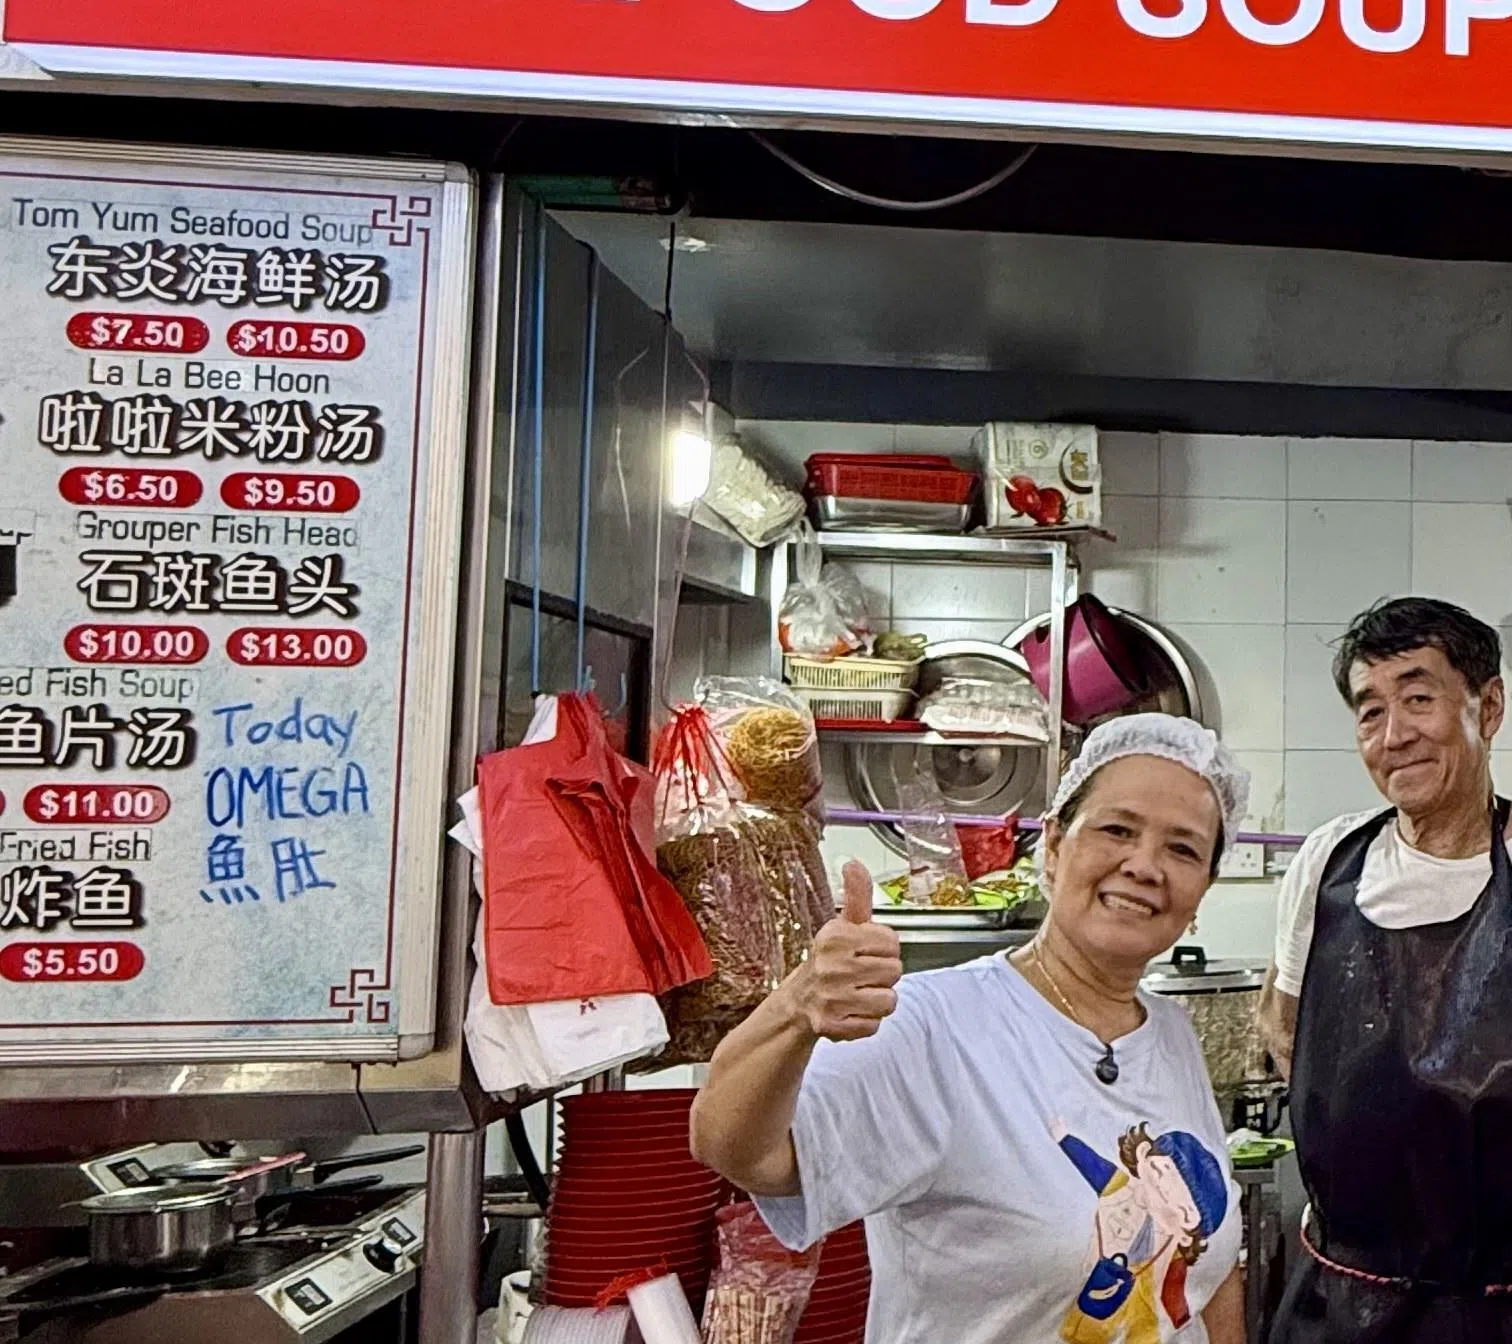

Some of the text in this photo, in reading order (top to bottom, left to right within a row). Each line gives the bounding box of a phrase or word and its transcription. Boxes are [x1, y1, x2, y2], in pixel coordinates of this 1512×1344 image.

[13, 199, 373, 245] Tom Yum Seafood Soup
[47, 236, 386, 312] 东炎海鲜汤
[89, 316, 350, 355] $7.50 $10.50
[88, 359, 330, 395] La La Bee Hoon
[40, 393, 382, 463] 啦啦米粉汤
[84, 472, 336, 507] $6.50 $9.50
[76, 511, 200, 550] Grouper
[211, 515, 271, 546] Fish
[78, 552, 361, 617] 石斑鱼头
[78, 629, 353, 663] $10.00 $13.00
[46, 668, 107, 698] Fish
[118, 668, 195, 703] Soup
[212, 697, 360, 758] Today
[38, 789, 155, 819] $11.00
[205, 763, 370, 828] OMEGA
[89, 830, 151, 861] Fish
[0, 865, 141, 929] 炸鱼
[22, 948, 120, 977] $5.50
